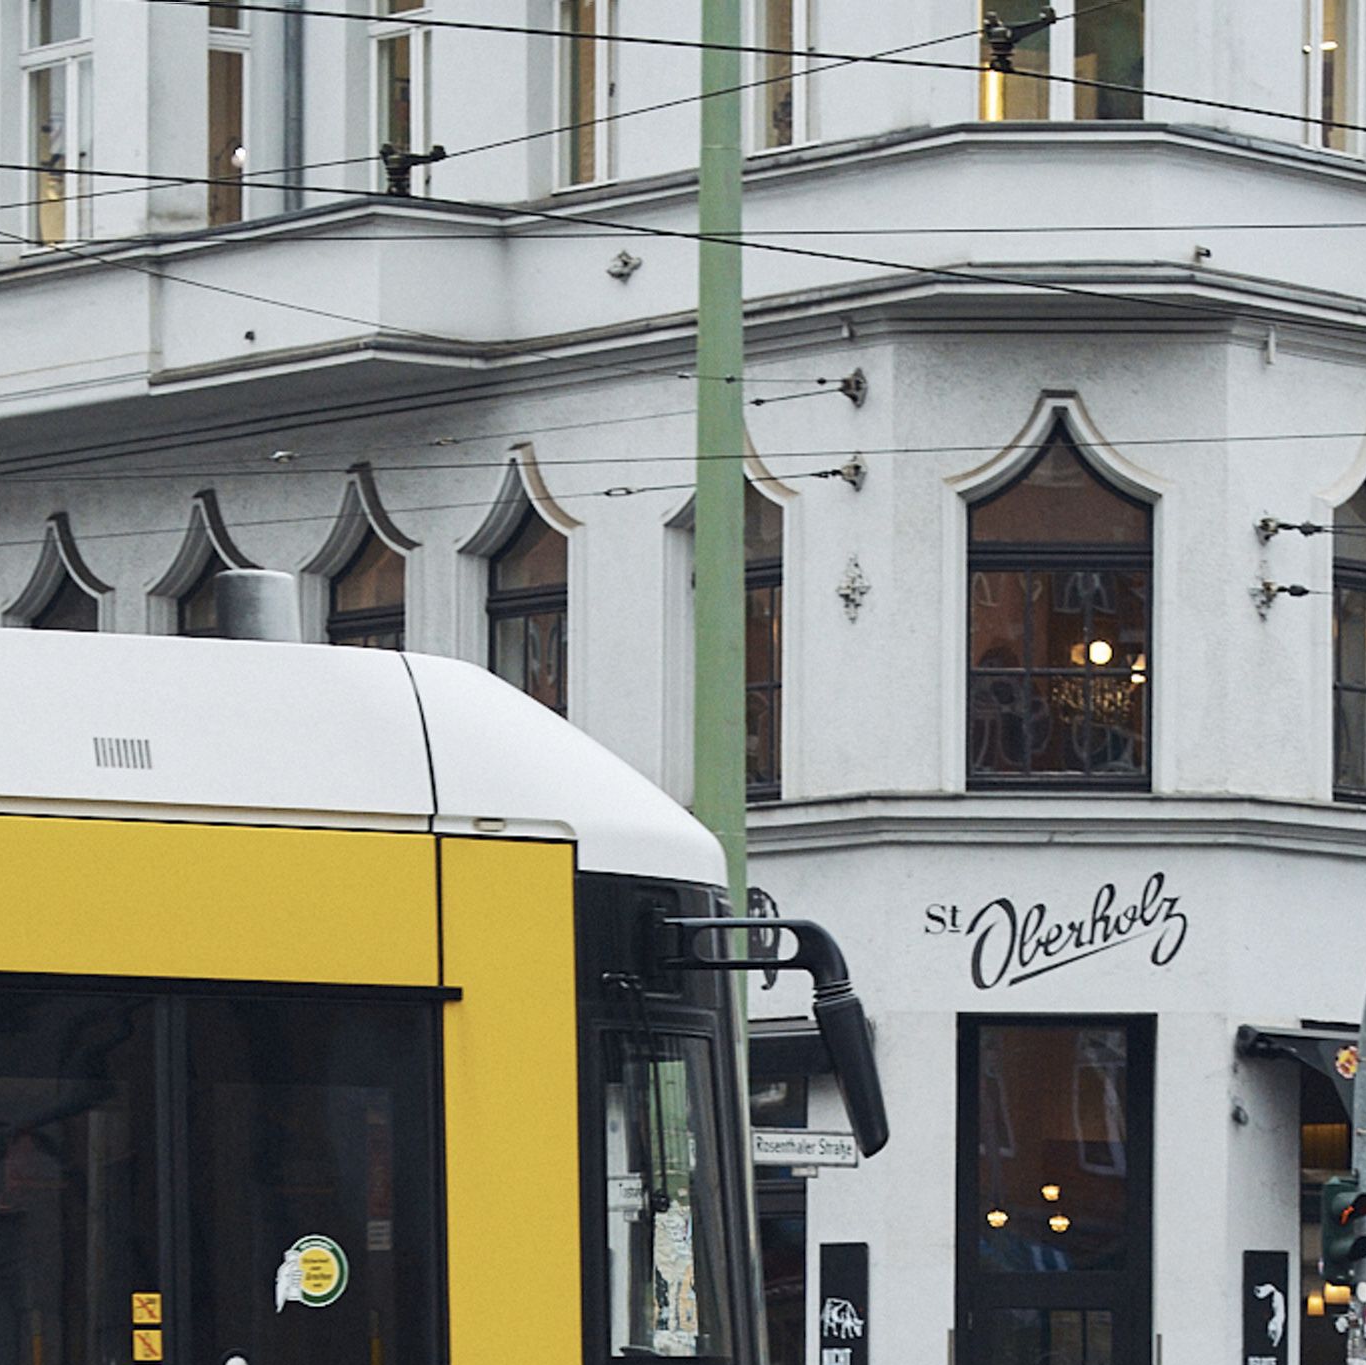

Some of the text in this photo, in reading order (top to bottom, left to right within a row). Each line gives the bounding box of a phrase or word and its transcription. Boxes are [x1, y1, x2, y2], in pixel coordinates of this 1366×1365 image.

[965, 871, 1188, 990] Oberholz
[755, 1136, 853, 1160] Rosenthaler Straße
